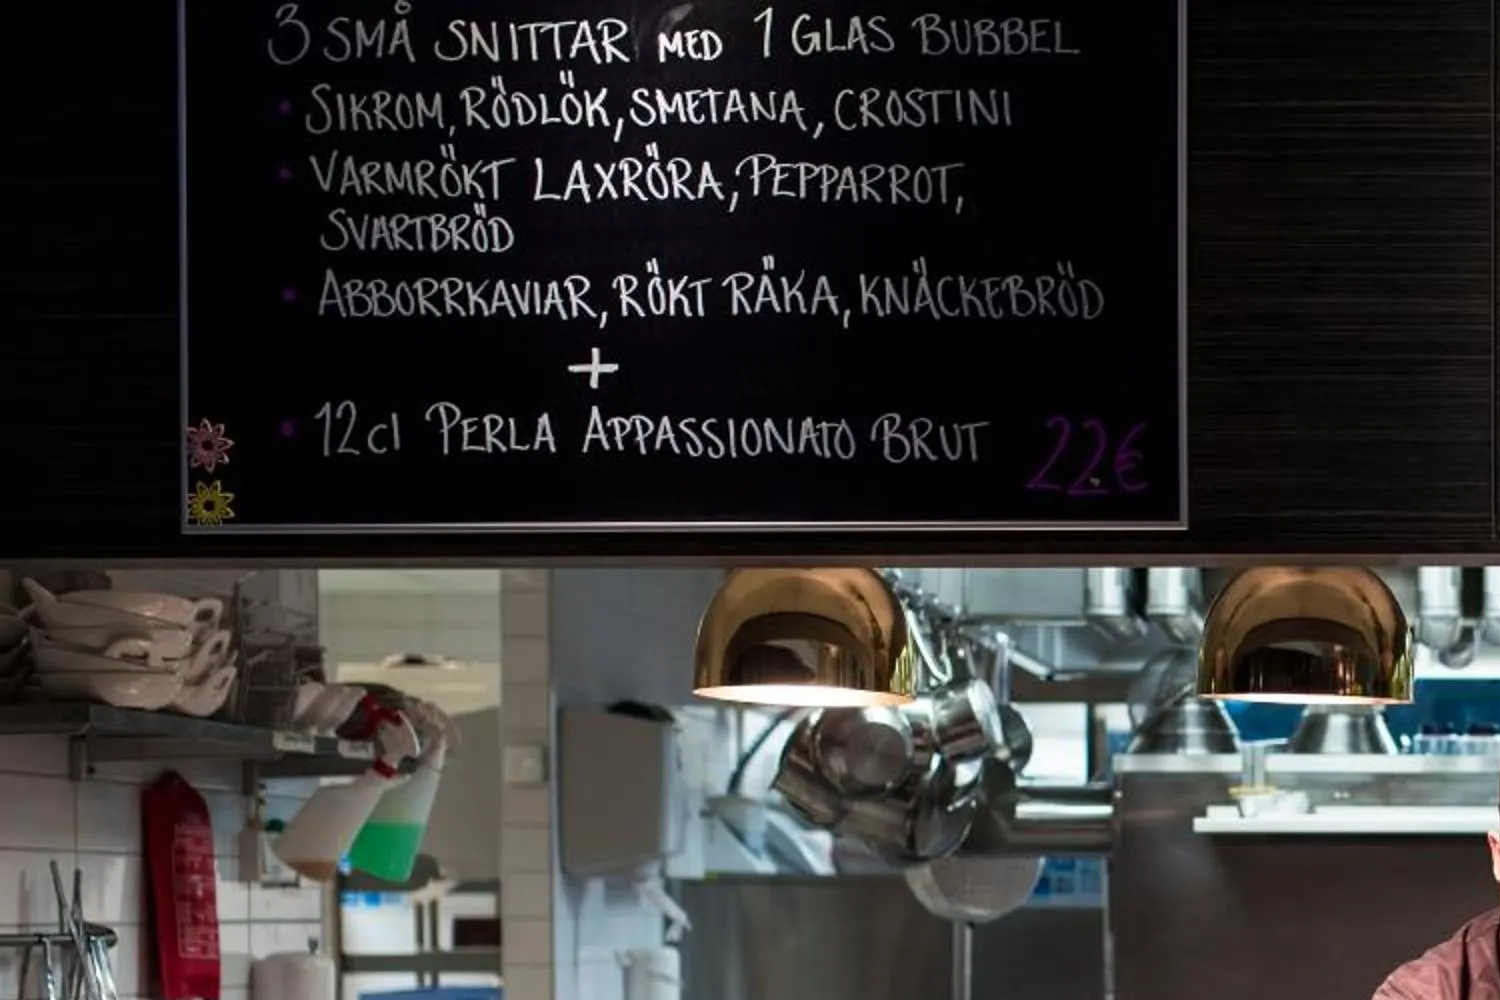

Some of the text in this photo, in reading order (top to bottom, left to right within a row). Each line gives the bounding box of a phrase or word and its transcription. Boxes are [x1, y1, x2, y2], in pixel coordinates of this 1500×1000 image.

[268, 0, 1081, 65] 3 SMÅ SNITTAR MED 1 GLAS BUBBEL
[834, 88, 1011, 130] CROSTINI
[309, 143, 516, 200] VARMRÖKT
[320, 203, 515, 252] SVARTBRÖD
[612, 260, 712, 318] RÖKT
[859, 255, 1105, 320] KNÄCKEBRÖD
[313, 401, 400, 456] 12cl
[425, 402, 557, 455] PERLA
[582, 405, 857, 459] APPASSIONATO
[870, 413, 991, 462] BRUT
